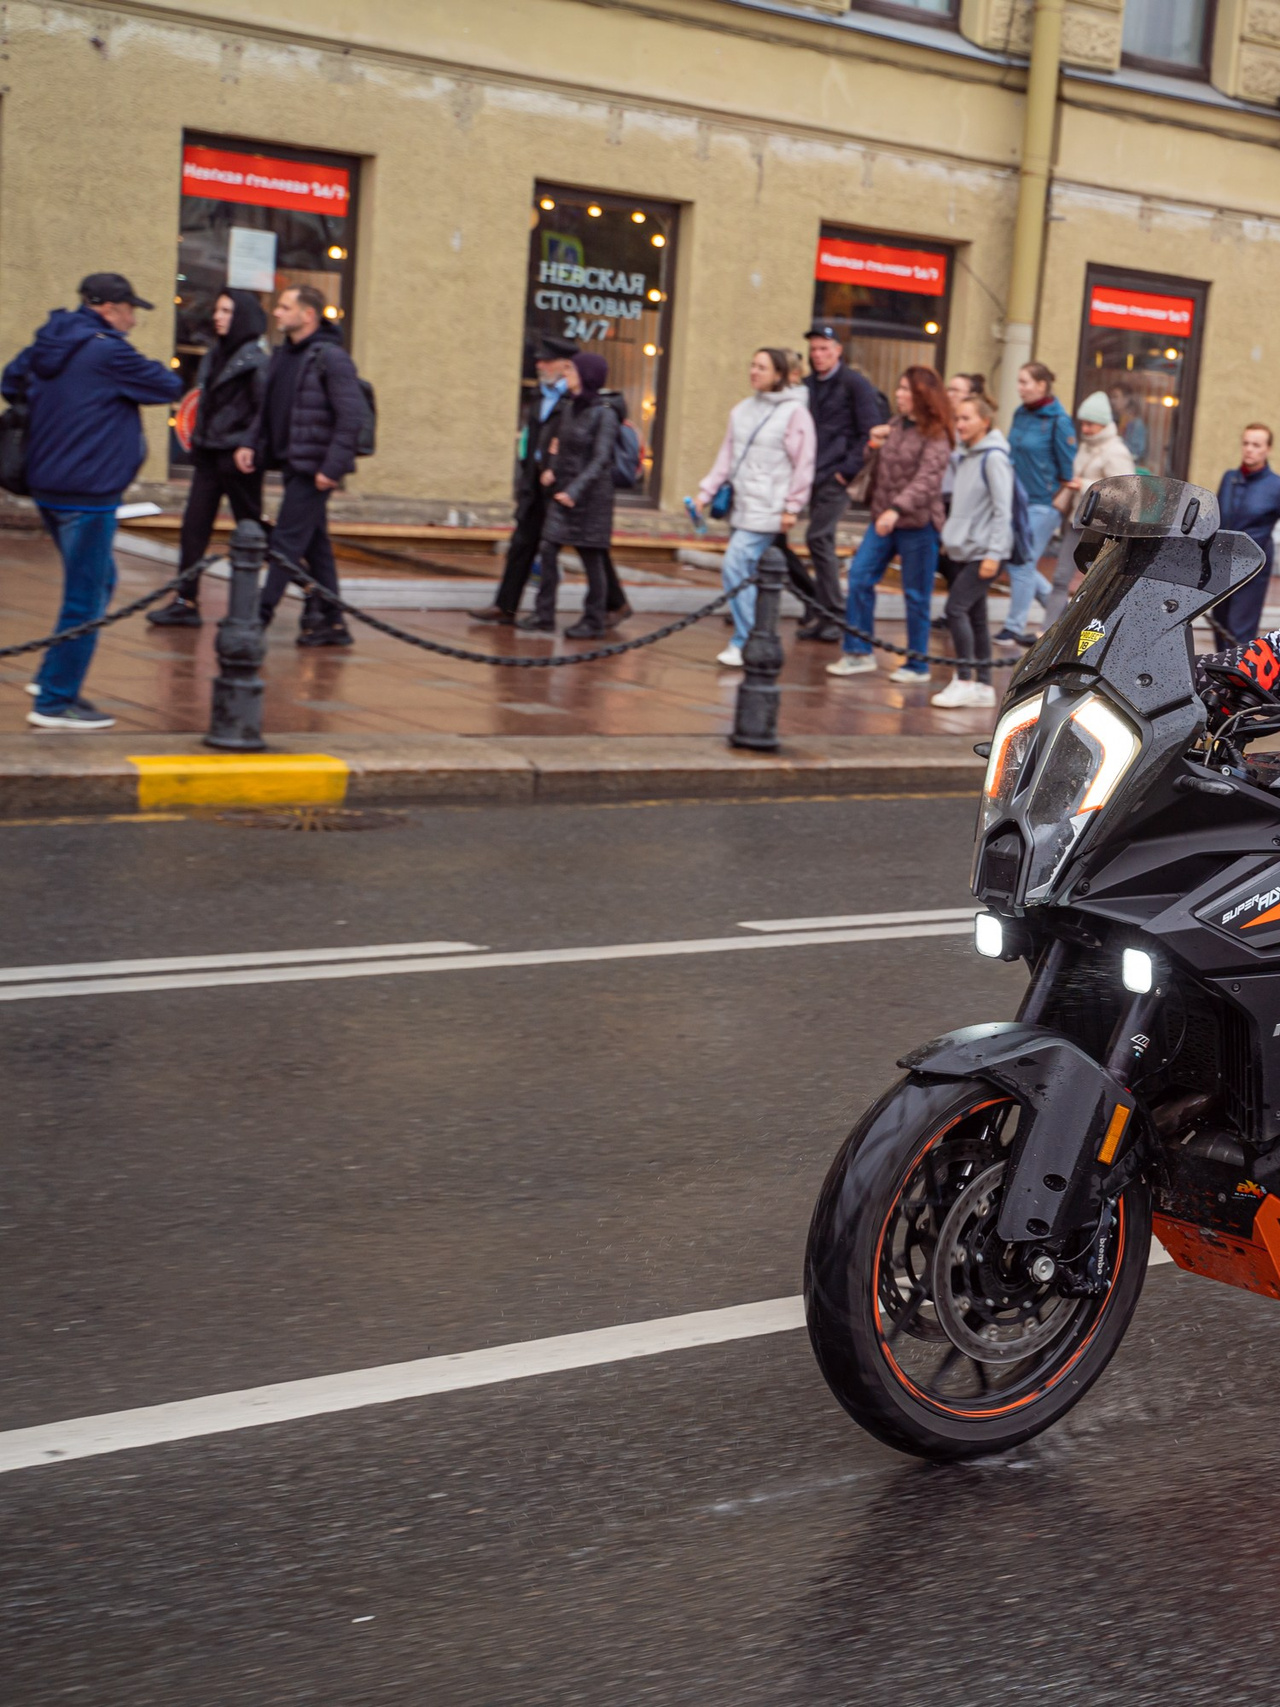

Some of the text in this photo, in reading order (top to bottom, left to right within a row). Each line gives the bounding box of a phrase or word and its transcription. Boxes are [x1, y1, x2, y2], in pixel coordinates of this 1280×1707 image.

[539, 260, 646, 296] НЕВСКАЯ
[534, 289, 642, 320] СТОЛОВАЯ
[563, 315, 610, 343] 24/7
[1221, 893, 1259, 925] SUPER
[1096, 1237, 1108, 1275] brembo
